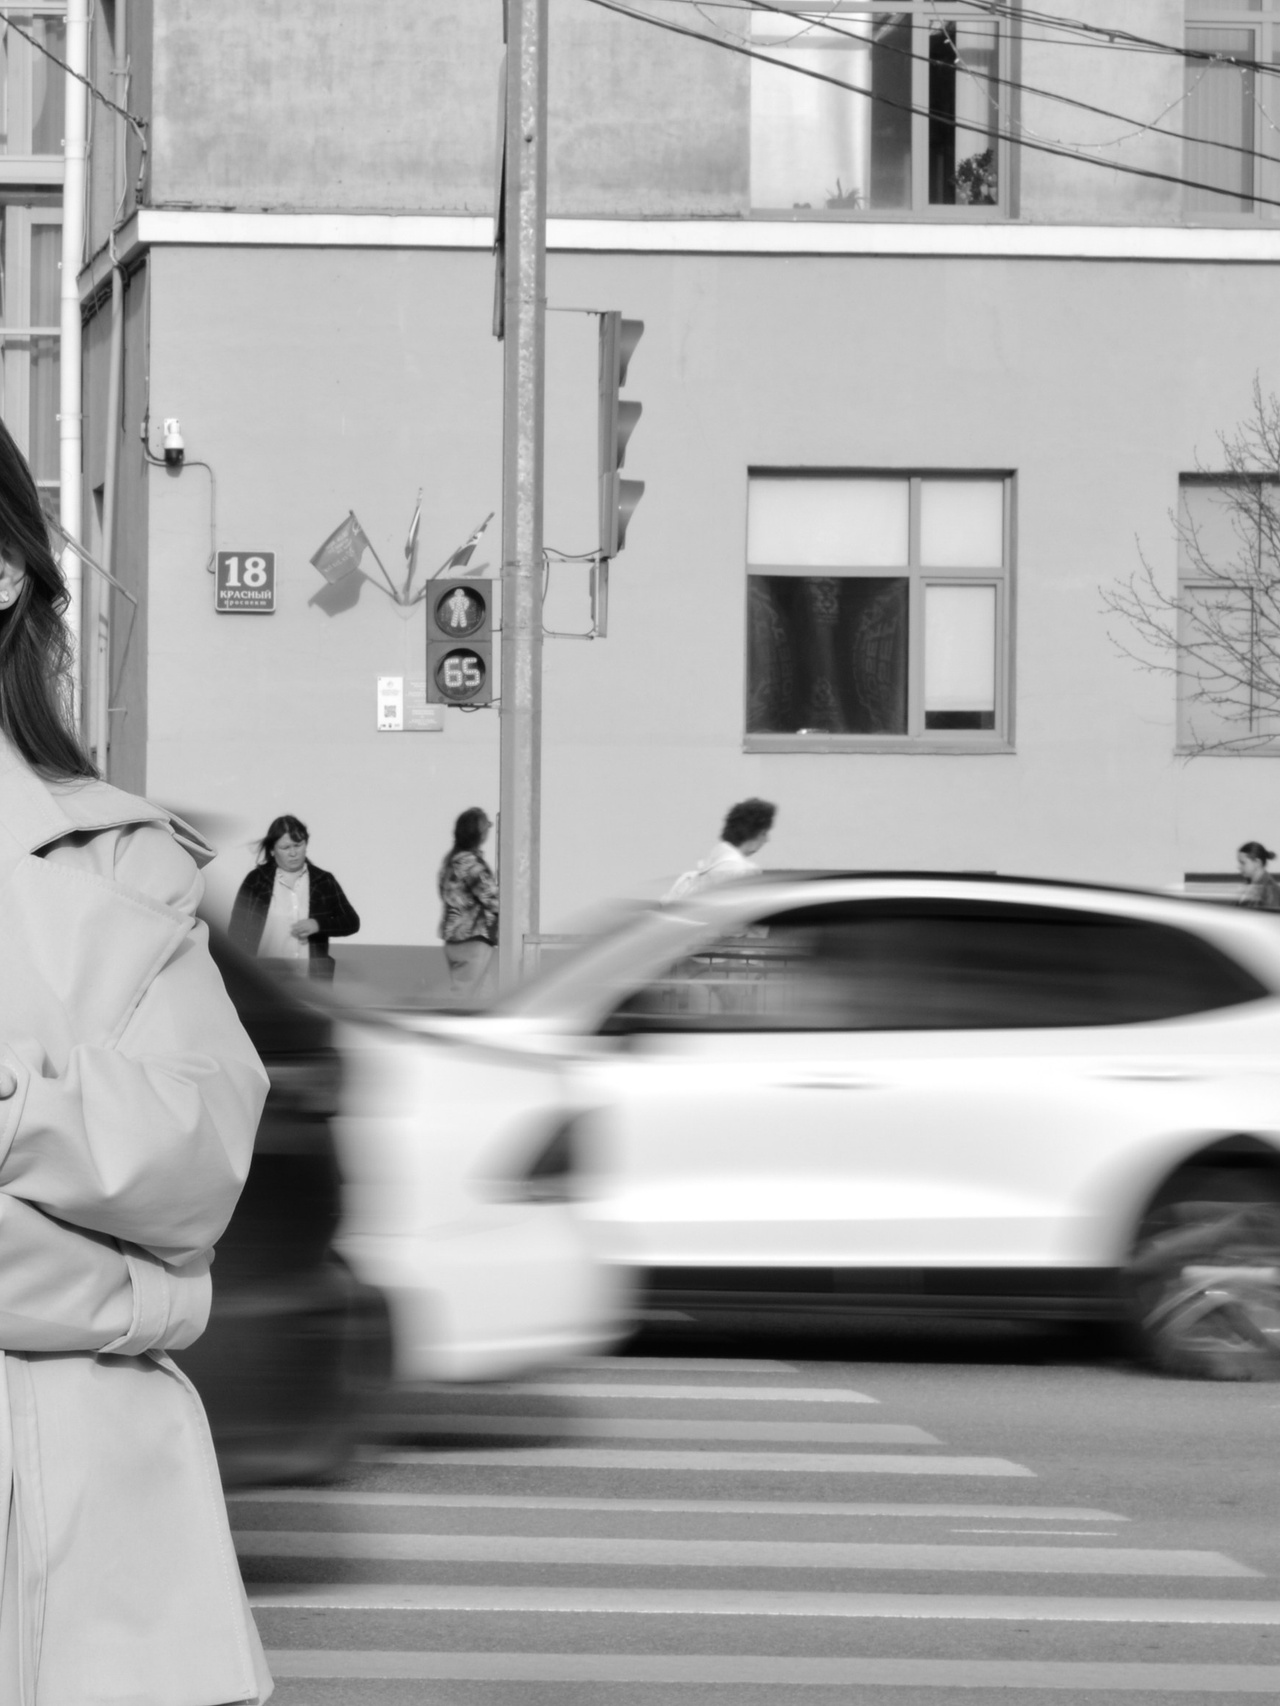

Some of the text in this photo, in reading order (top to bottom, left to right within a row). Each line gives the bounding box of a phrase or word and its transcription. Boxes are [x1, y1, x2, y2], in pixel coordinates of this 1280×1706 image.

[225, 556, 267, 587] 18
[220, 589, 272, 599] КРАСНЫЙ
[444, 657, 480, 687] 65
